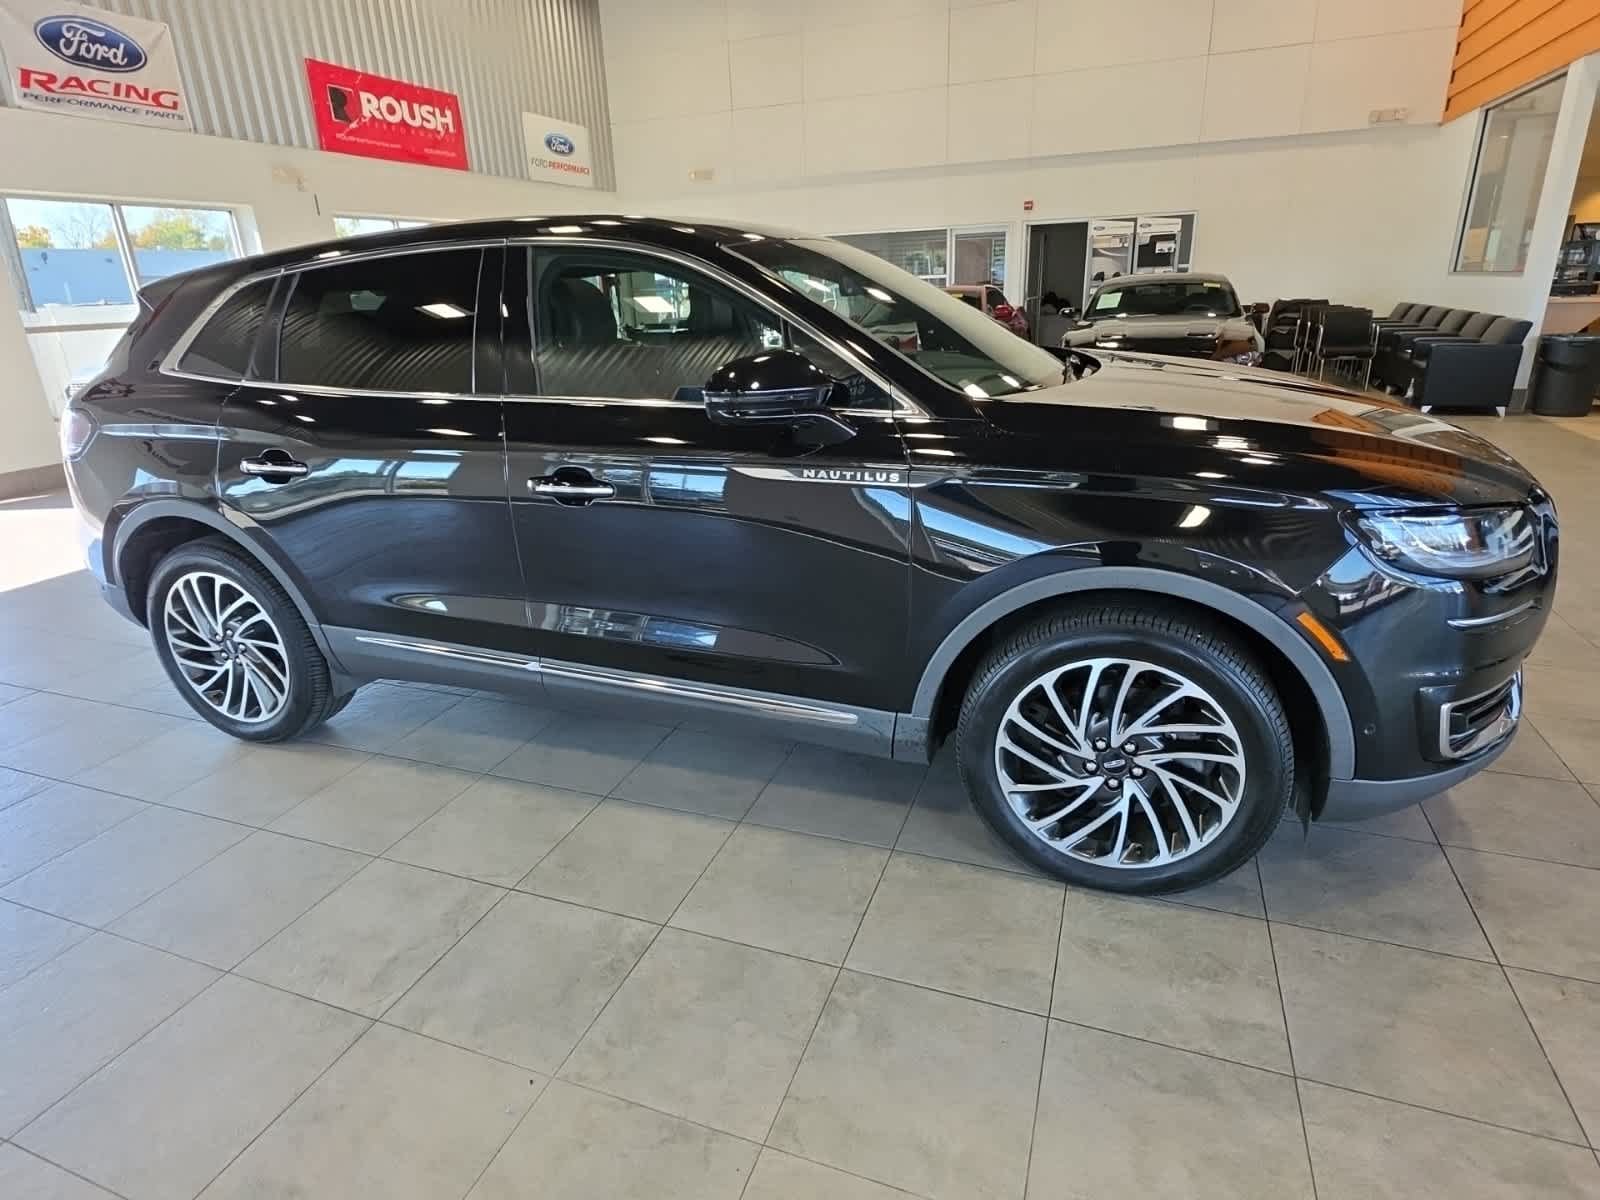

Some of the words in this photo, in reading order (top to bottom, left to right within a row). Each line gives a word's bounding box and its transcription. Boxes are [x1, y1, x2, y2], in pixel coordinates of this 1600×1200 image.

[60, 23, 128, 66] Ford
[19, 67, 180, 111] RACING
[23, 92, 138, 115] PERFORMANCE
[145, 110, 185, 121] PARTS
[359, 91, 455, 134] ROUSH
[550, 136, 570, 153] Ford
[548, 160, 590, 176] PERFORMANC
[802, 469, 900, 483] NAUTILUS
